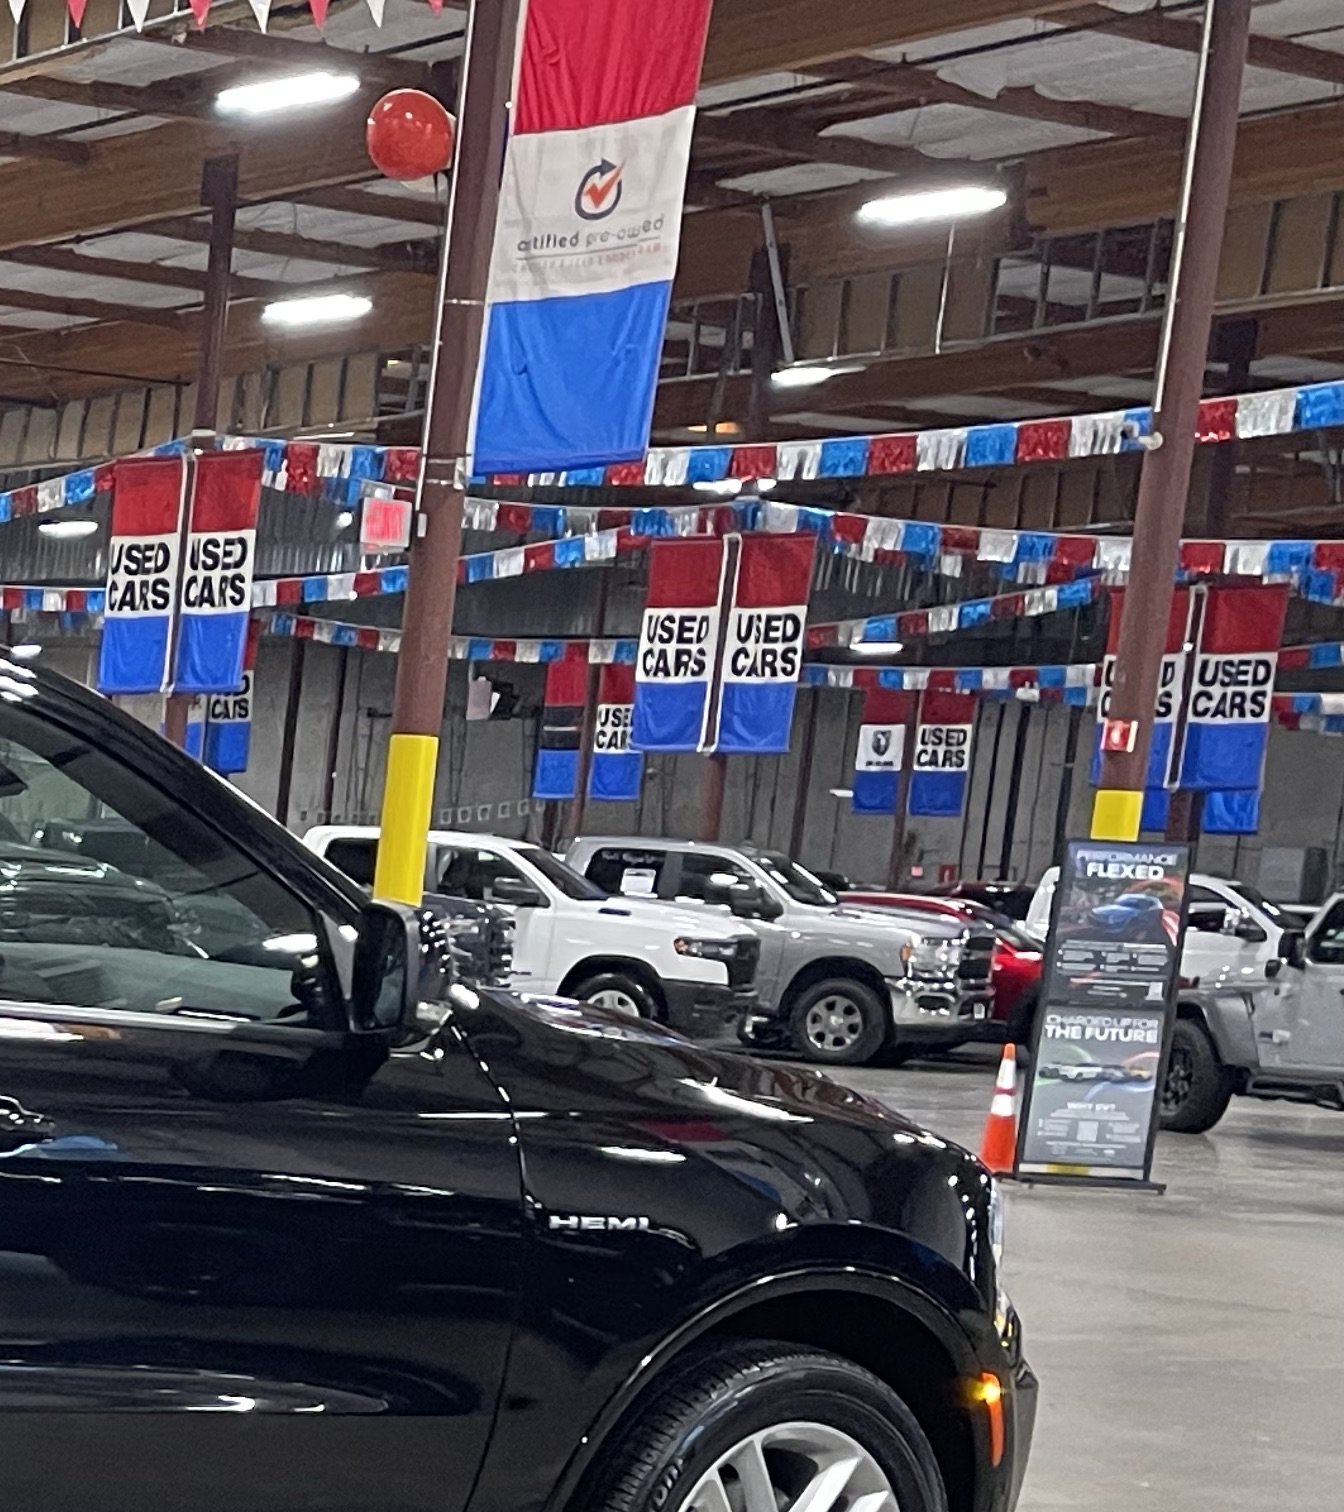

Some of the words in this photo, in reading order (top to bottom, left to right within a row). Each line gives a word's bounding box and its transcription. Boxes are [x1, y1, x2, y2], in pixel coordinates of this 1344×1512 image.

[517, 231, 580, 253] crtified
[586, 213, 665, 249] pre-owed
[111, 542, 171, 576] USED
[189, 536, 248, 571] USED
[108, 577, 170, 611] CARS
[184, 573, 246, 607] CARS
[646, 614, 710, 644] USED
[736, 613, 801, 644] USED
[642, 647, 707, 677] CARS
[731, 646, 798, 677] CARS
[1105, 659, 1176, 689] UD
[1199, 659, 1272, 688] USED
[598, 707, 632, 728] USE
[1101, 690, 1173, 718] CS
[1192, 690, 1267, 718] CARS
[595, 729, 632, 750] CAR
[920, 727, 968, 747] USED
[916, 748, 966, 768] CARS
[1087, 861, 1165, 880] FLEXED
[1045, 1024, 1082, 1040] THE
[1085, 1026, 1158, 1044] FUTURE
[549, 1215, 650, 1230] HEMI
